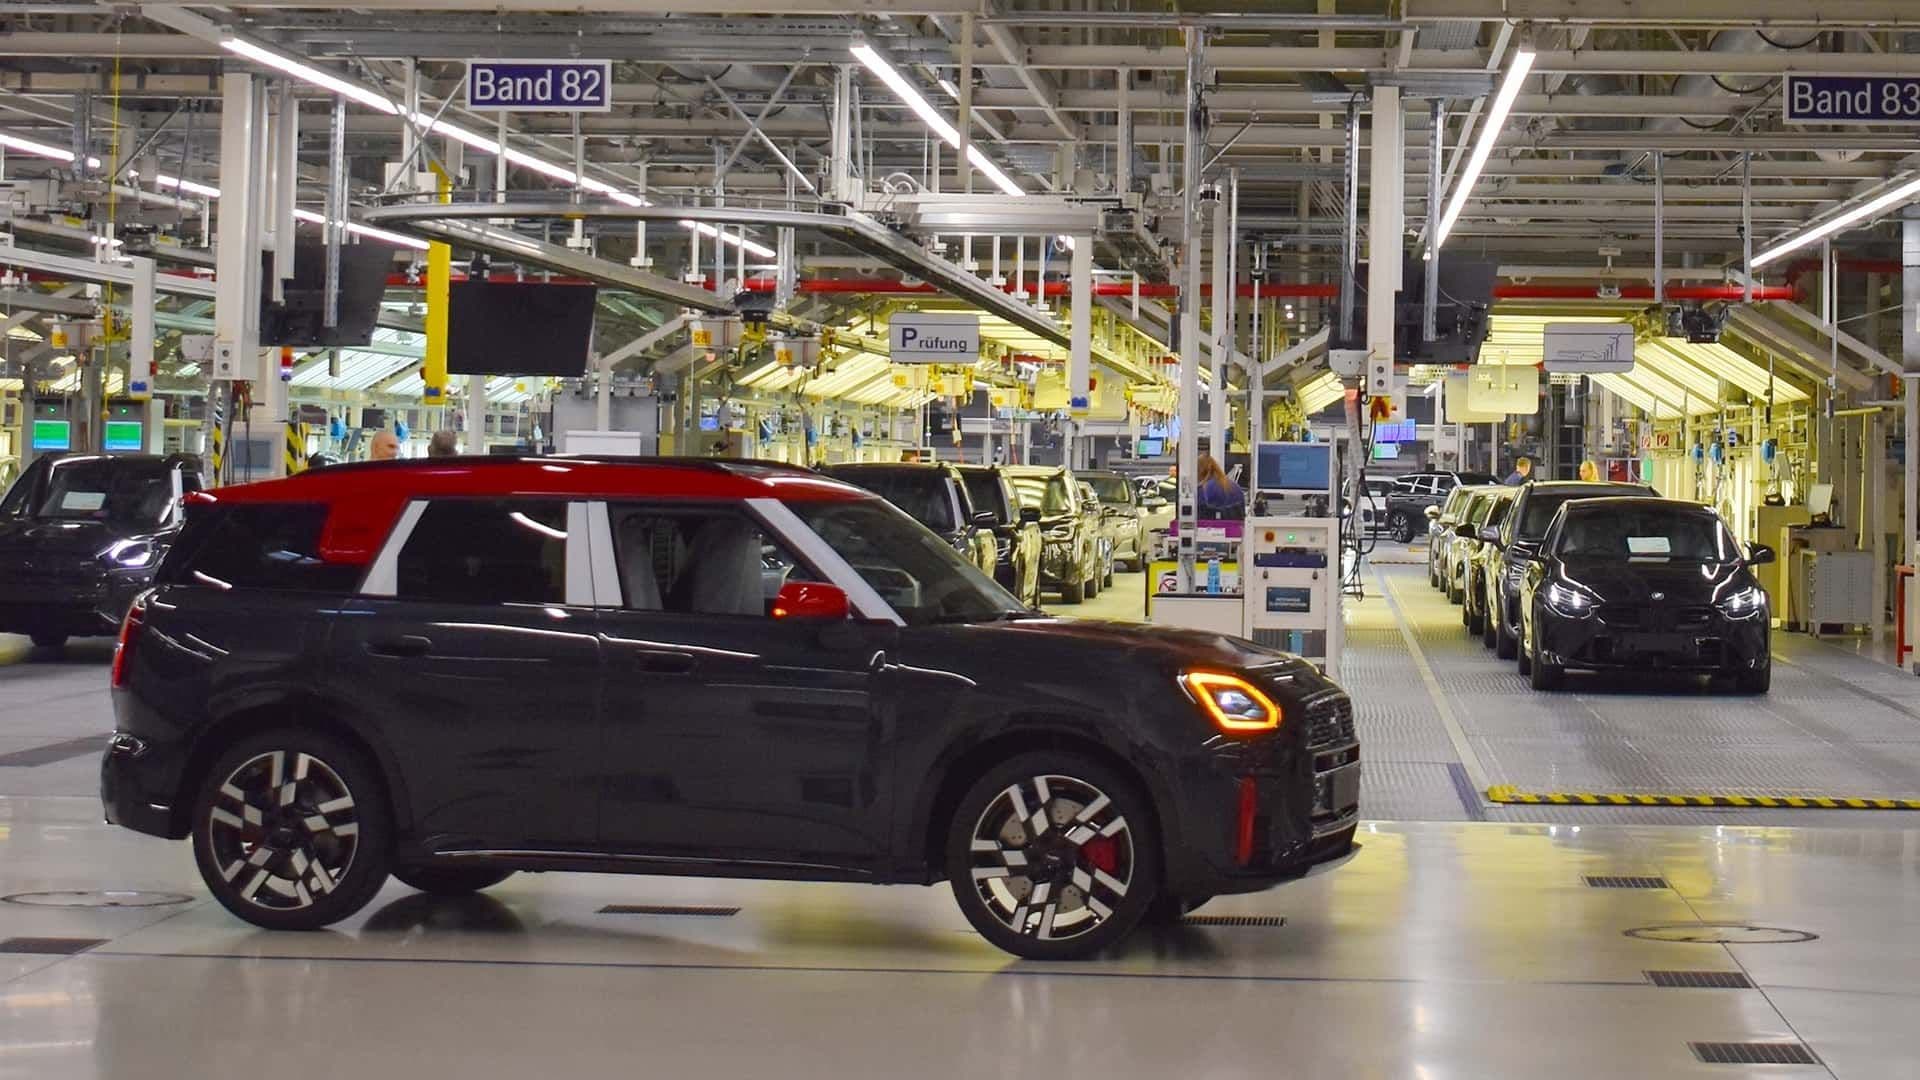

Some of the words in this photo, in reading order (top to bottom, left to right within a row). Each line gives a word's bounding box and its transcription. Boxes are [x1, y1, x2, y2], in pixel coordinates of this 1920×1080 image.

[475, 68, 553, 101] Band
[561, 69, 601, 101] 82
[1793, 81, 1872, 114] Band
[1881, 83, 1920, 115] 83
[902, 327, 967, 352] Prüfung
